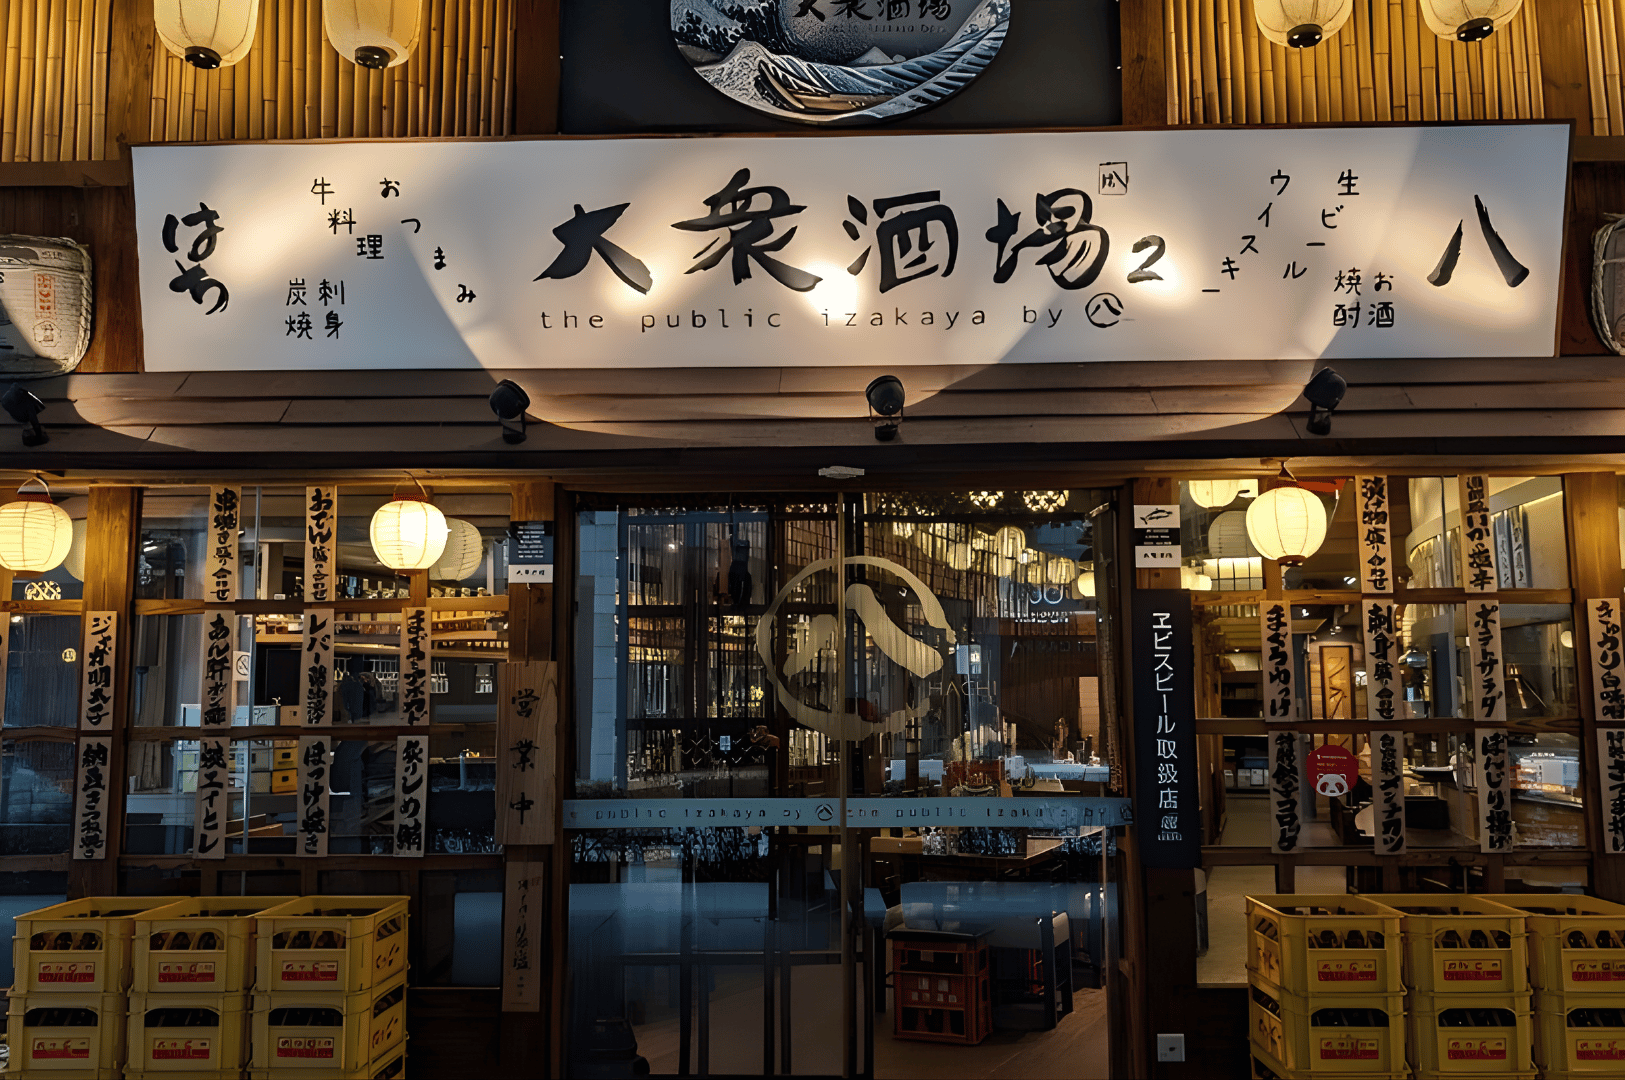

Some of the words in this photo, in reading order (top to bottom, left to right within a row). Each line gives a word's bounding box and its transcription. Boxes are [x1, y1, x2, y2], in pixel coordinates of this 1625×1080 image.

[161, 201, 230, 316] はち
[311, 177, 386, 260] 牛料理
[379, 178, 477, 303] おつまみ
[1428, 194, 1530, 288] 八
[542, 310, 604, 329] the
[642, 308, 780, 333] public
[823, 307, 985, 331] izakaya
[1024, 305, 1063, 329] by
[1266, 604, 1292, 718] まぐろゆっけ
[1474, 603, 1504, 718] ポテトサラダ
[509, 687, 541, 826] 営業中
